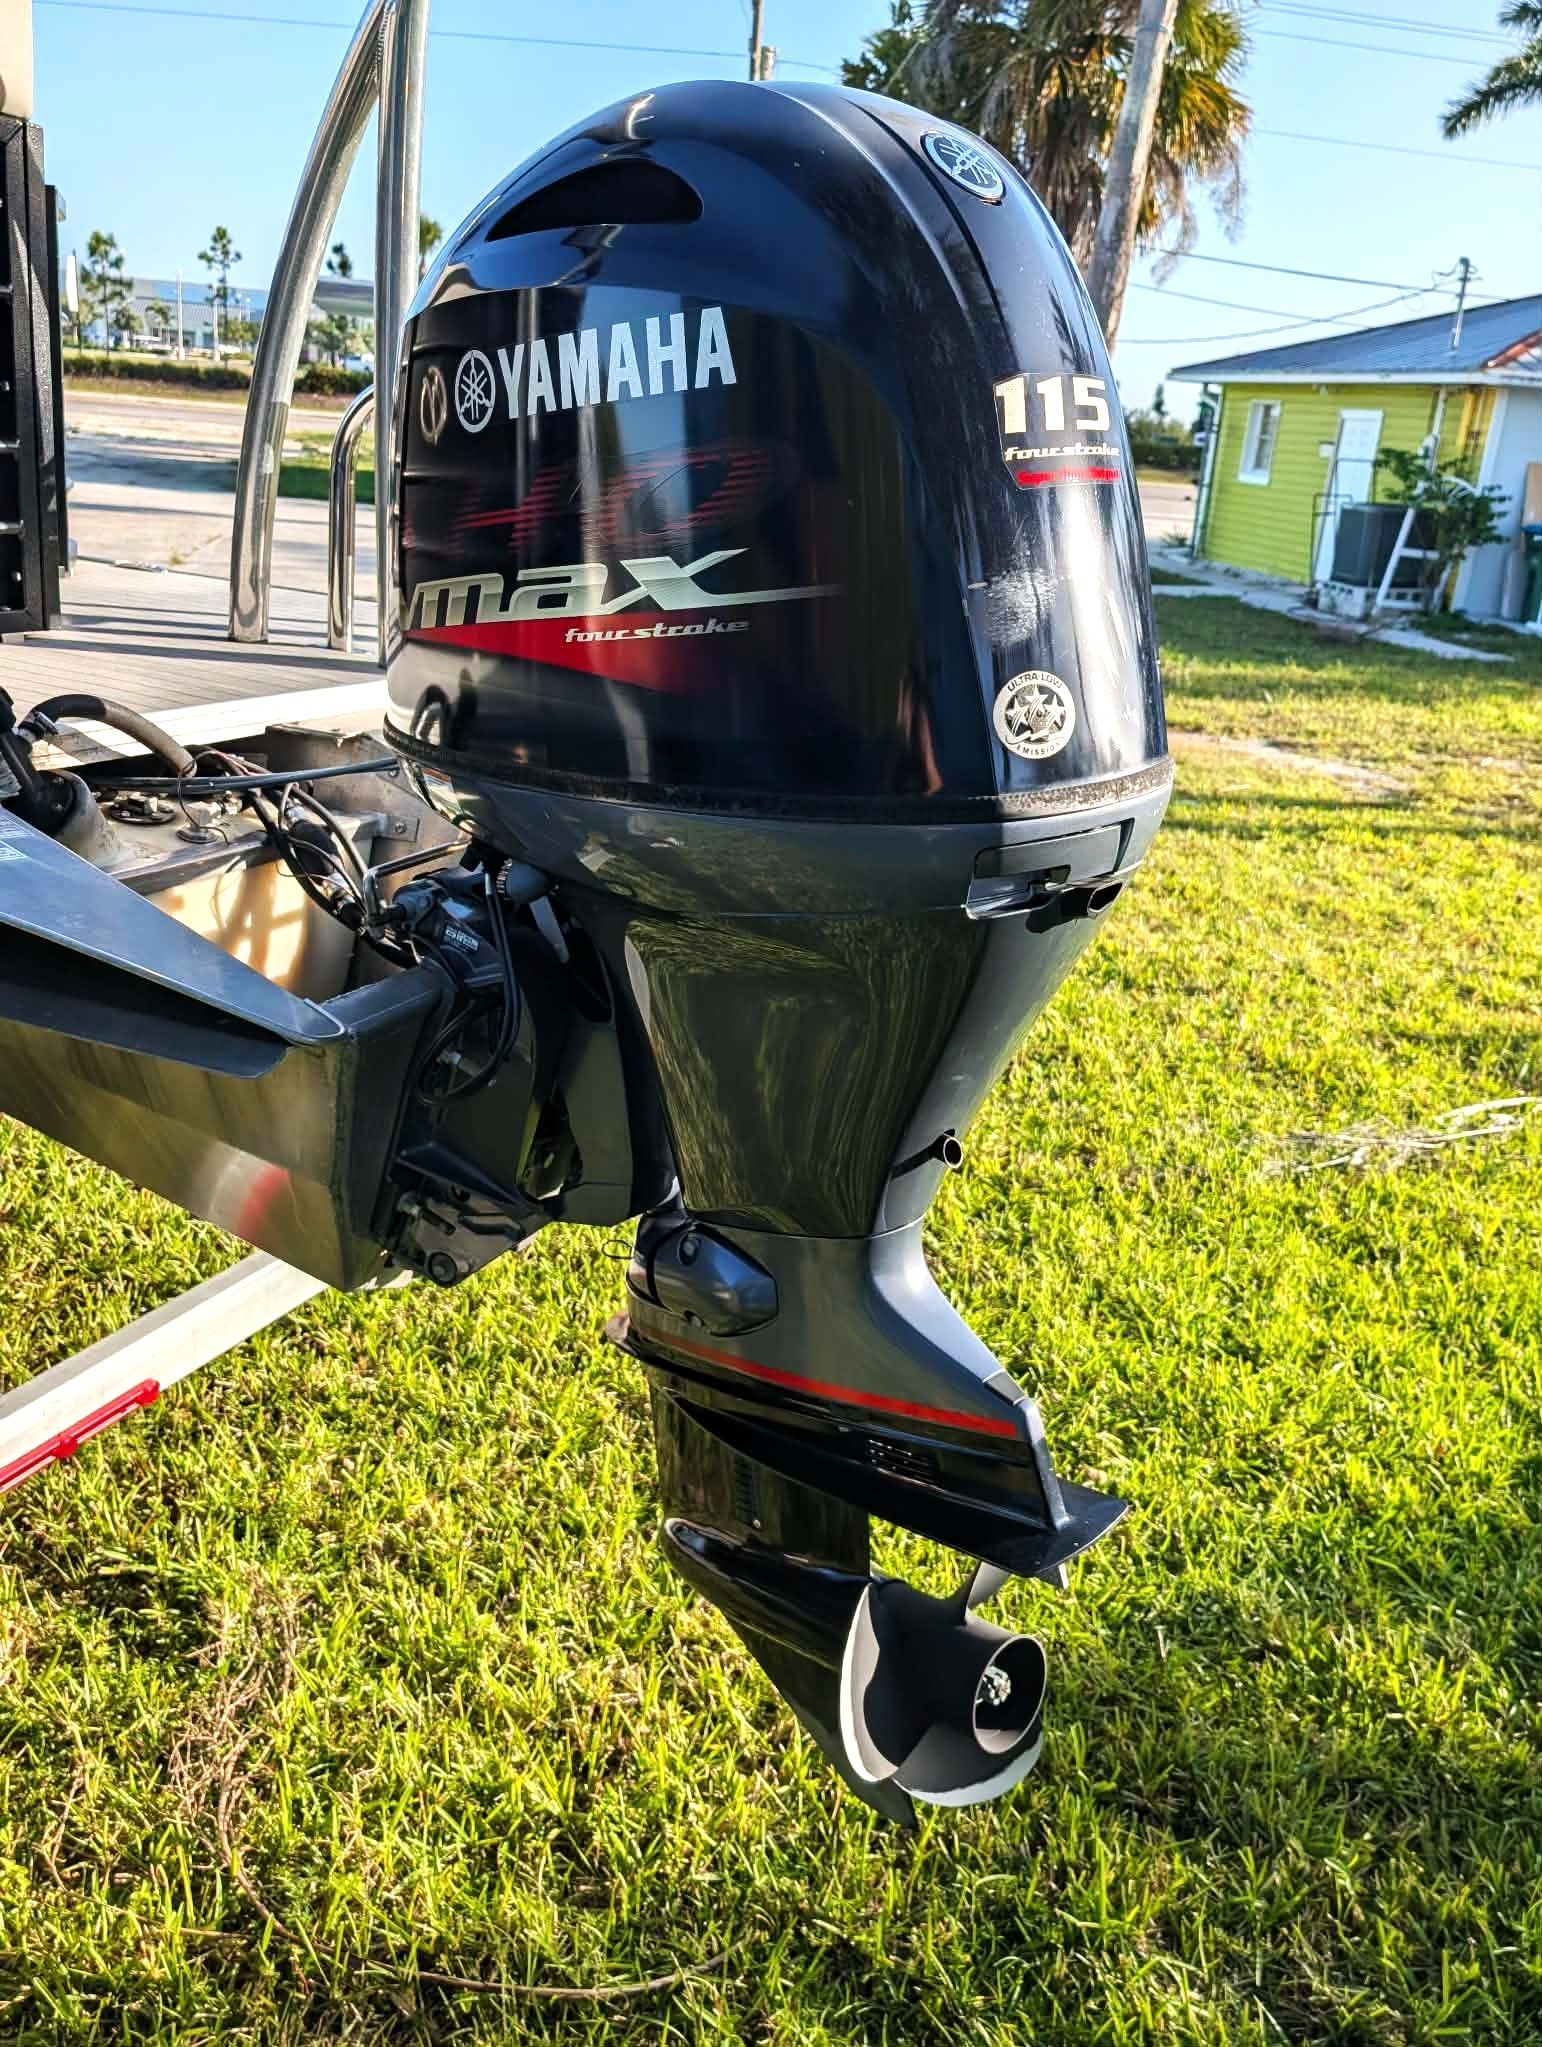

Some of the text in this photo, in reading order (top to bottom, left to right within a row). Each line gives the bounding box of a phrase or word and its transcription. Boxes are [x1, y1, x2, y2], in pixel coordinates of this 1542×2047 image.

[497, 306, 736, 419] YAMAHA
[995, 375, 1110, 434] 115
[1007, 672, 1039, 692] ULTRA
